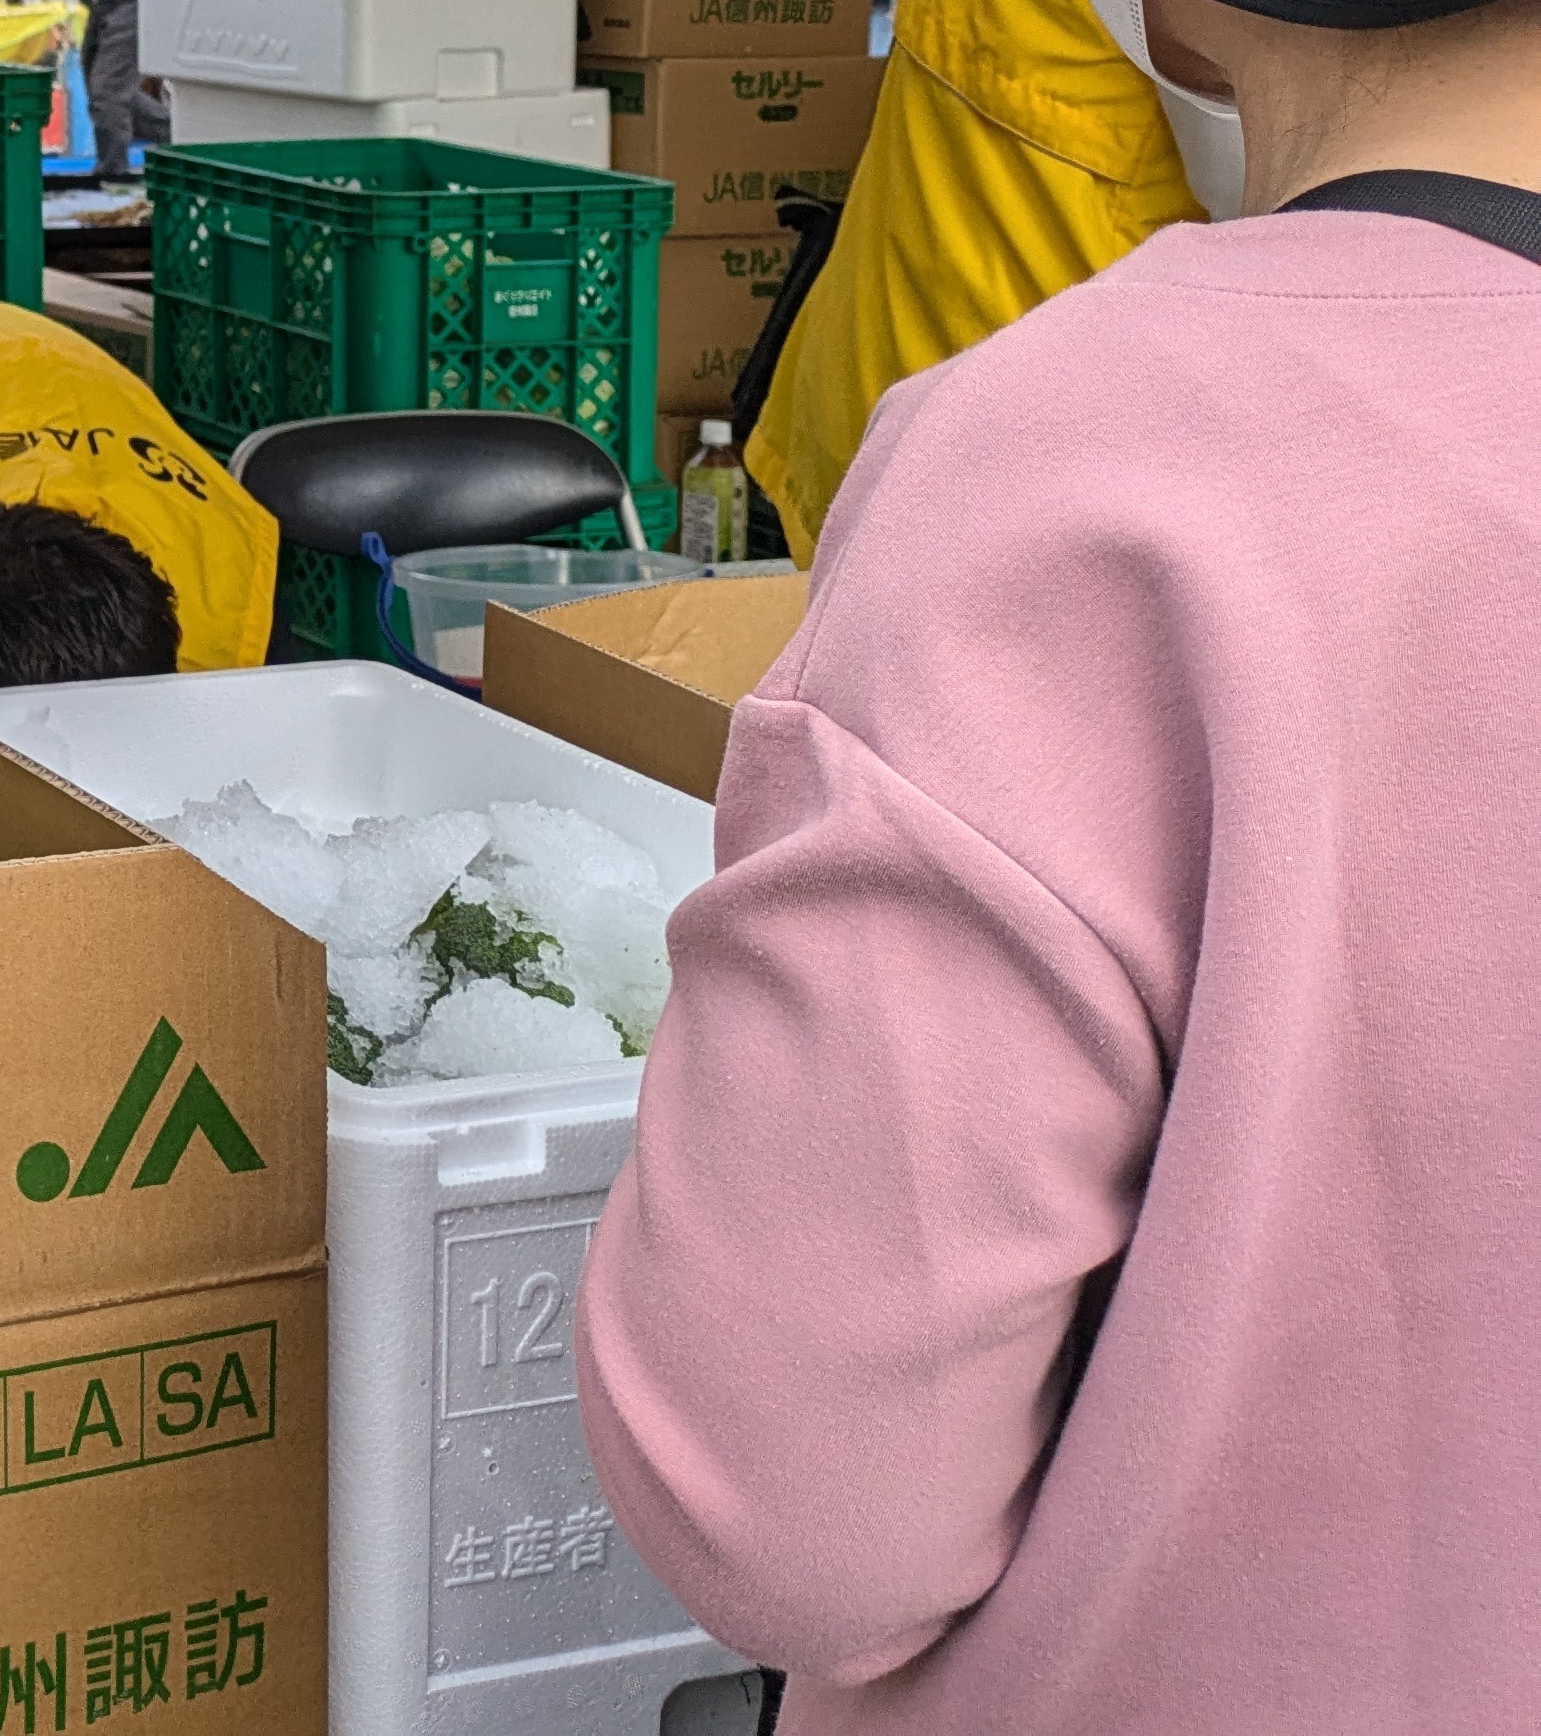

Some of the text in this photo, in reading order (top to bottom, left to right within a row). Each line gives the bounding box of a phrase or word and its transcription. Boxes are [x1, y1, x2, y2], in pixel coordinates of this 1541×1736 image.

[731, 69, 824, 100] セルリー
[23, 1377, 125, 1466] LA
[156, 1350, 259, 1437] SA
[443, 1506, 615, 1590] 生産者
